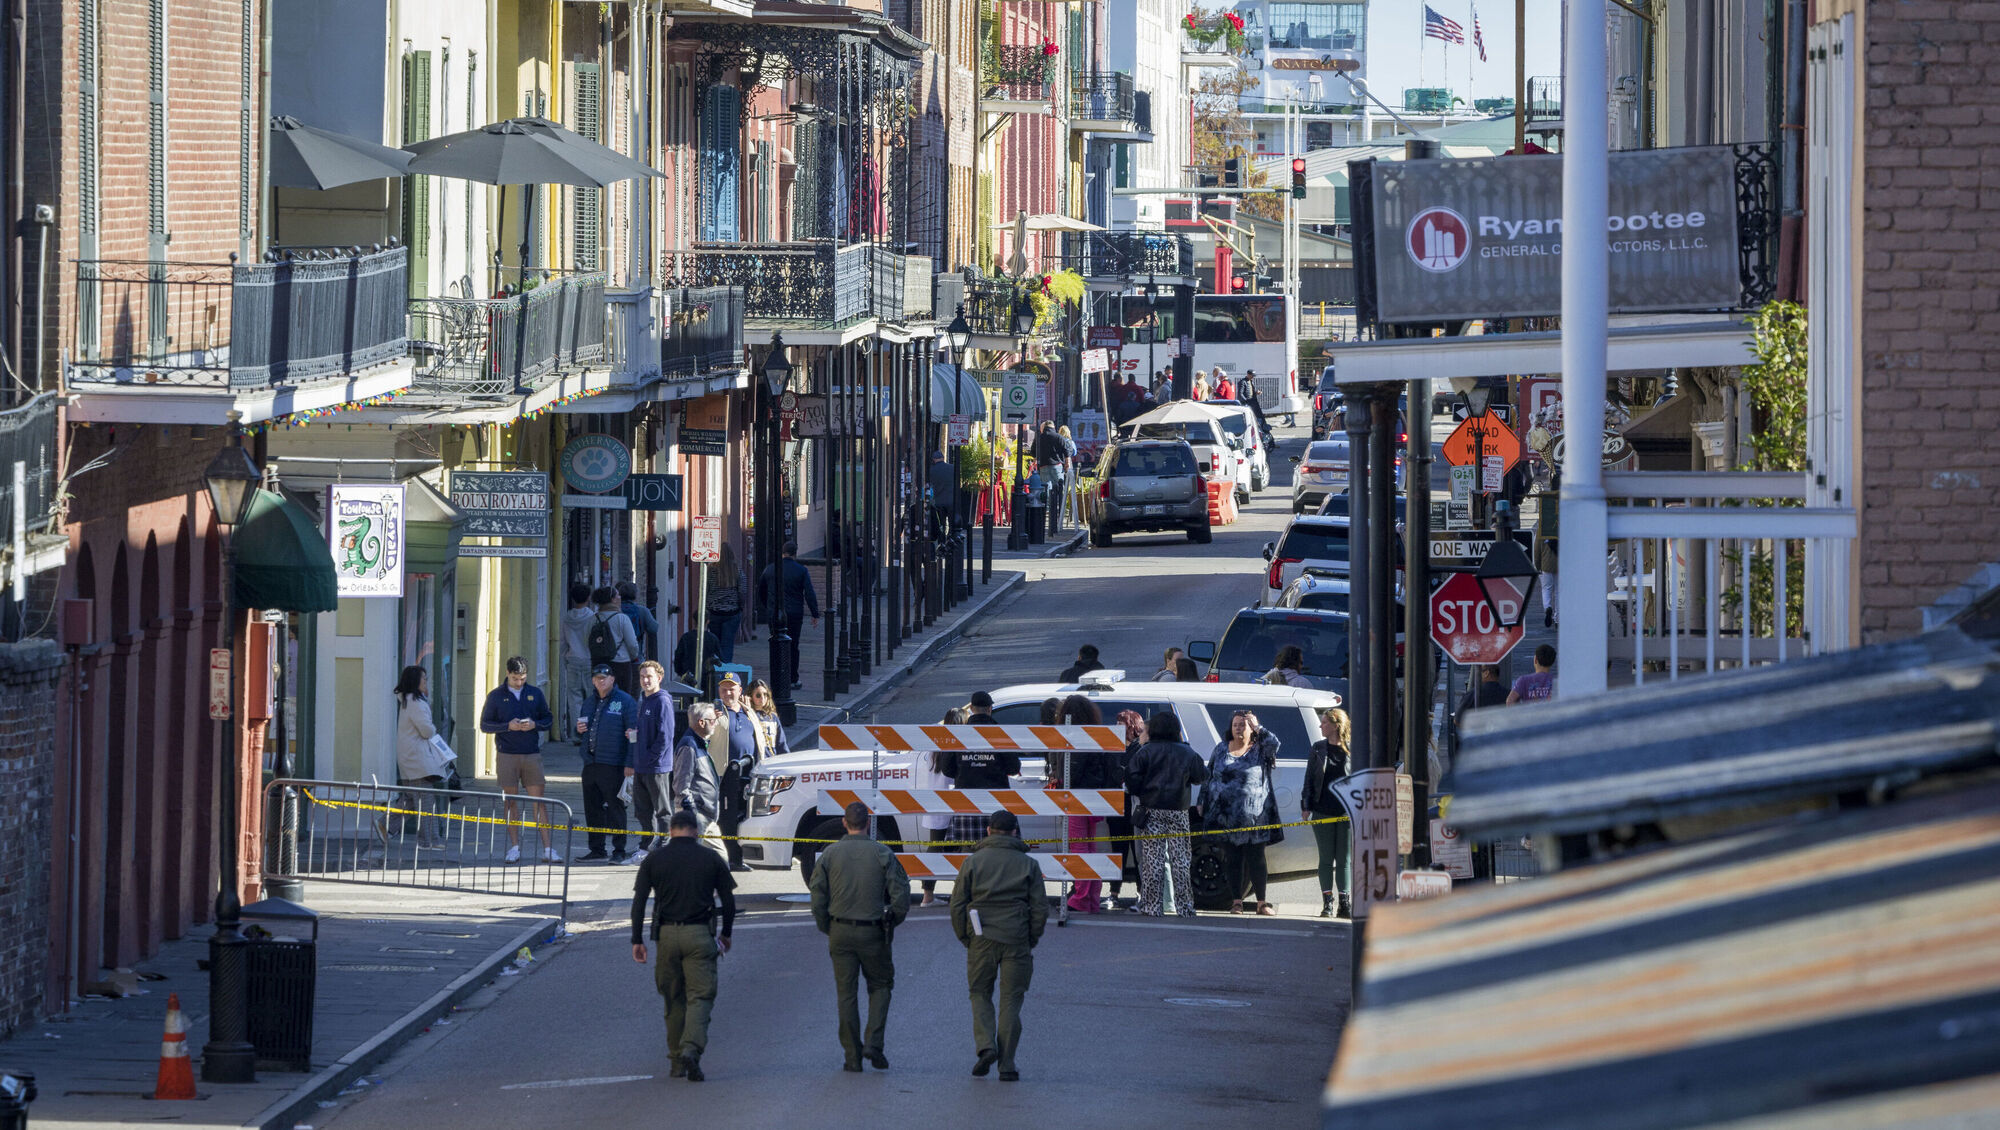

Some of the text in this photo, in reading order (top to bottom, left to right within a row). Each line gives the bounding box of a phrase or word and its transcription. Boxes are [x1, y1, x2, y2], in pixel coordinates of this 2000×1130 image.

[1479, 210, 1706, 240] Ryan ootee
[1480, 244, 1549, 259] GENERAL
[1669, 237, 1708, 251] L.L.C.
[1466, 427, 1500, 438] RAD
[562, 436, 612, 468] SOUTHERN
[611, 443, 628, 468] PAWS
[679, 444, 724, 453] COMMERCIAL
[1466, 443, 1499, 455] WRK
[453, 493, 488, 508] ROUX
[491, 493, 546, 509] ROYALE
[340, 502, 382, 516] Toulouse
[697, 541, 715, 549] LANE
[1433, 542, 1463, 556] ONE
[337, 584, 348, 592] ew
[1437, 600, 1518, 635] STOP
[961, 753, 995, 761] MACHINA
[801, 771, 842, 783] STATE
[1350, 788, 1394, 811] SPEED
[1361, 819, 1390, 841] LIMIT
[1361, 849, 1389, 901] 15
